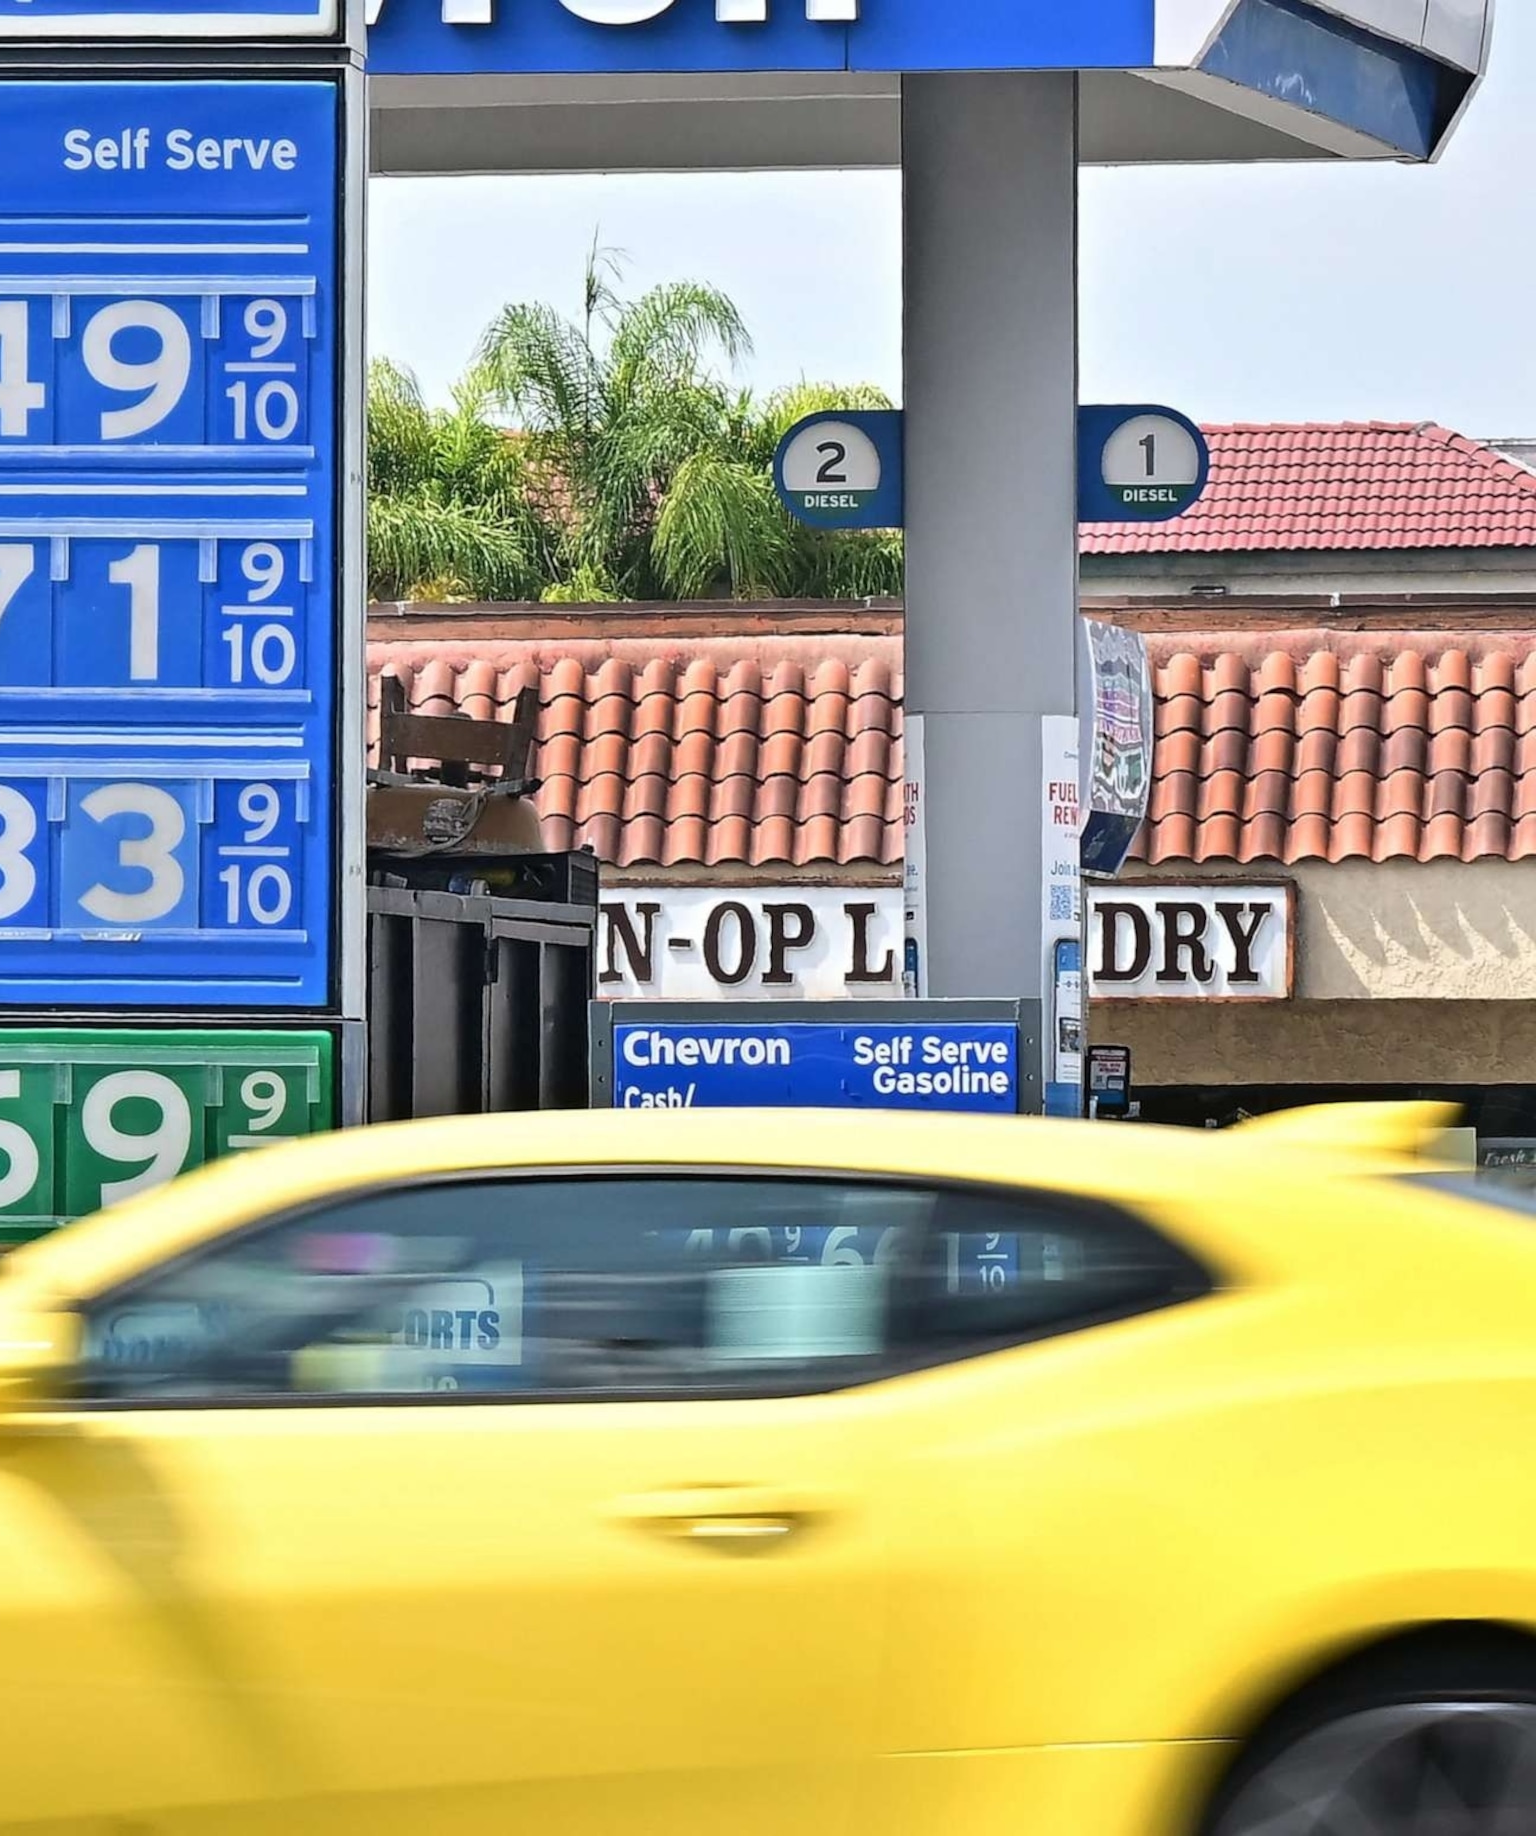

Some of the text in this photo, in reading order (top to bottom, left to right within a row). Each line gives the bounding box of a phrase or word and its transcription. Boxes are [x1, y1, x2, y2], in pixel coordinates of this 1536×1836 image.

[64, 127, 150, 171] Self
[166, 130, 298, 171] Serve
[816, 441, 846, 483] 2
[1138, 434, 1155, 477] 1
[804, 495, 858, 508] DIESEL
[1122, 489, 1177, 503] DIESEL
[1049, 783, 1077, 803] FUEL
[1050, 861, 1071, 877] Join
[1093, 902, 1271, 983] DRY
[623, 1031, 1008, 1067] Chevron Self Serve
[873, 1067, 1009, 1094] Gasoline
[624, 1083, 697, 1108] Cash/
